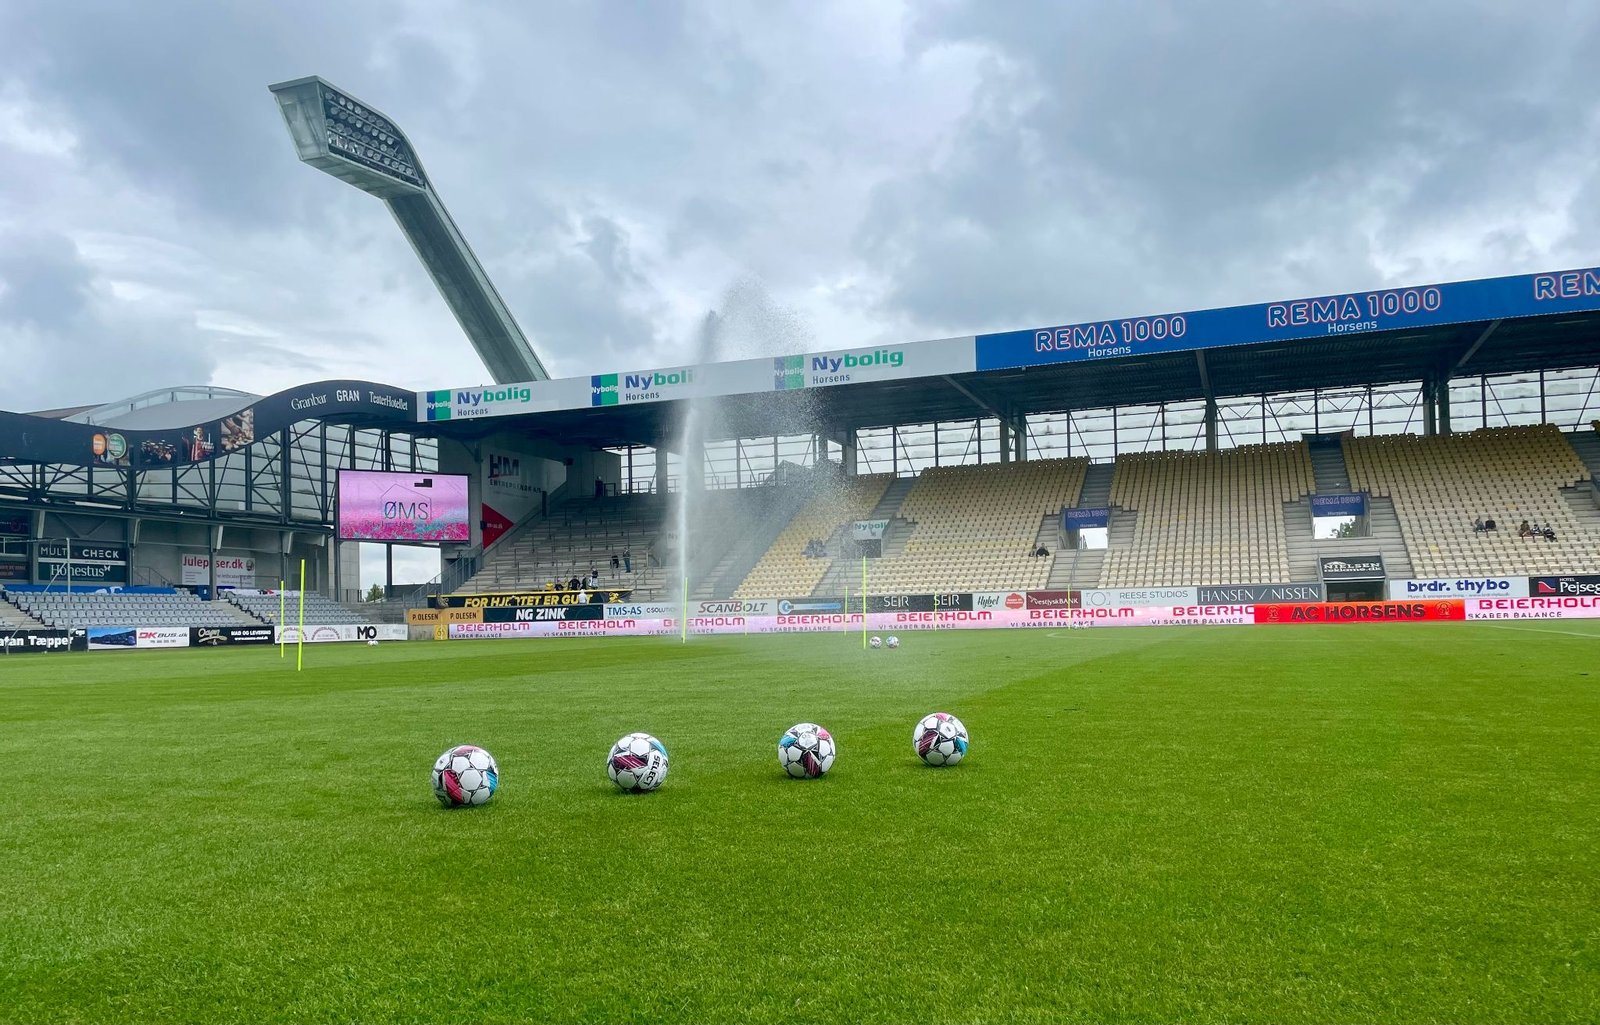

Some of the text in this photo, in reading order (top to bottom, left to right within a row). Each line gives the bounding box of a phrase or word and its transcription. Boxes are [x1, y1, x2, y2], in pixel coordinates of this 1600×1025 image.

[1267, 288, 1441, 328] REMA 1000
[1327, 319, 1378, 334] Horsens
[1035, 315, 1186, 352] REMA 1000
[1087, 345, 1132, 358] Horsens
[812, 350, 904, 373] Nybolig
[774, 367, 804, 376] Nybolig
[625, 369, 694, 390] Nyboli
[812, 373, 850, 385] Horsens
[336, 390, 360, 402] GRAN
[457, 386, 531, 407] Nybolig
[591, 385, 619, 395] Nybolig
[625, 391, 660, 401] Horsens
[291, 393, 327, 410] Granbar
[457, 407, 489, 417] Horsens
[489, 454, 519, 477] HM
[384, 500, 429, 520] ØMS
[40, 546, 119, 559] MULT CHECK
[183, 556, 243, 569] Julepser.dk
[51, 564, 105, 577] Honestus
[1407, 579, 1510, 593] brdr. thybo
[464, 597, 489, 608] FOR
[543, 594, 560, 606] ER
[561, 593, 593, 605] GUT
[1119, 590, 1189, 600] REESE STUDIOS
[1201, 589, 1254, 602] HANSEN
[1271, 587, 1319, 600] NISSEN
[607, 606, 642, 616] TMS-AS
[698, 601, 768, 613] SCANBOLT
[1030, 607, 1135, 619] BEIERHOLM
[1291, 603, 1425, 620] AC HORSENS
[417, 613, 439, 621] OLESEN
[455, 612, 477, 620] OLESEN
[515, 607, 567, 621] NG ZINK
[777, 613, 865, 625] BEIERHOLM
[896, 610, 993, 622] BEIERHOLM
[456, 622, 530, 632] BEIERHOLM
[557, 620, 636, 631] BEIERHOLM
[663, 617, 746, 628] BEERHOLM
[356, 625, 377, 639] MO
[28, 635, 74, 649] Tæpper
[646, 754, 661, 787] SELECT
